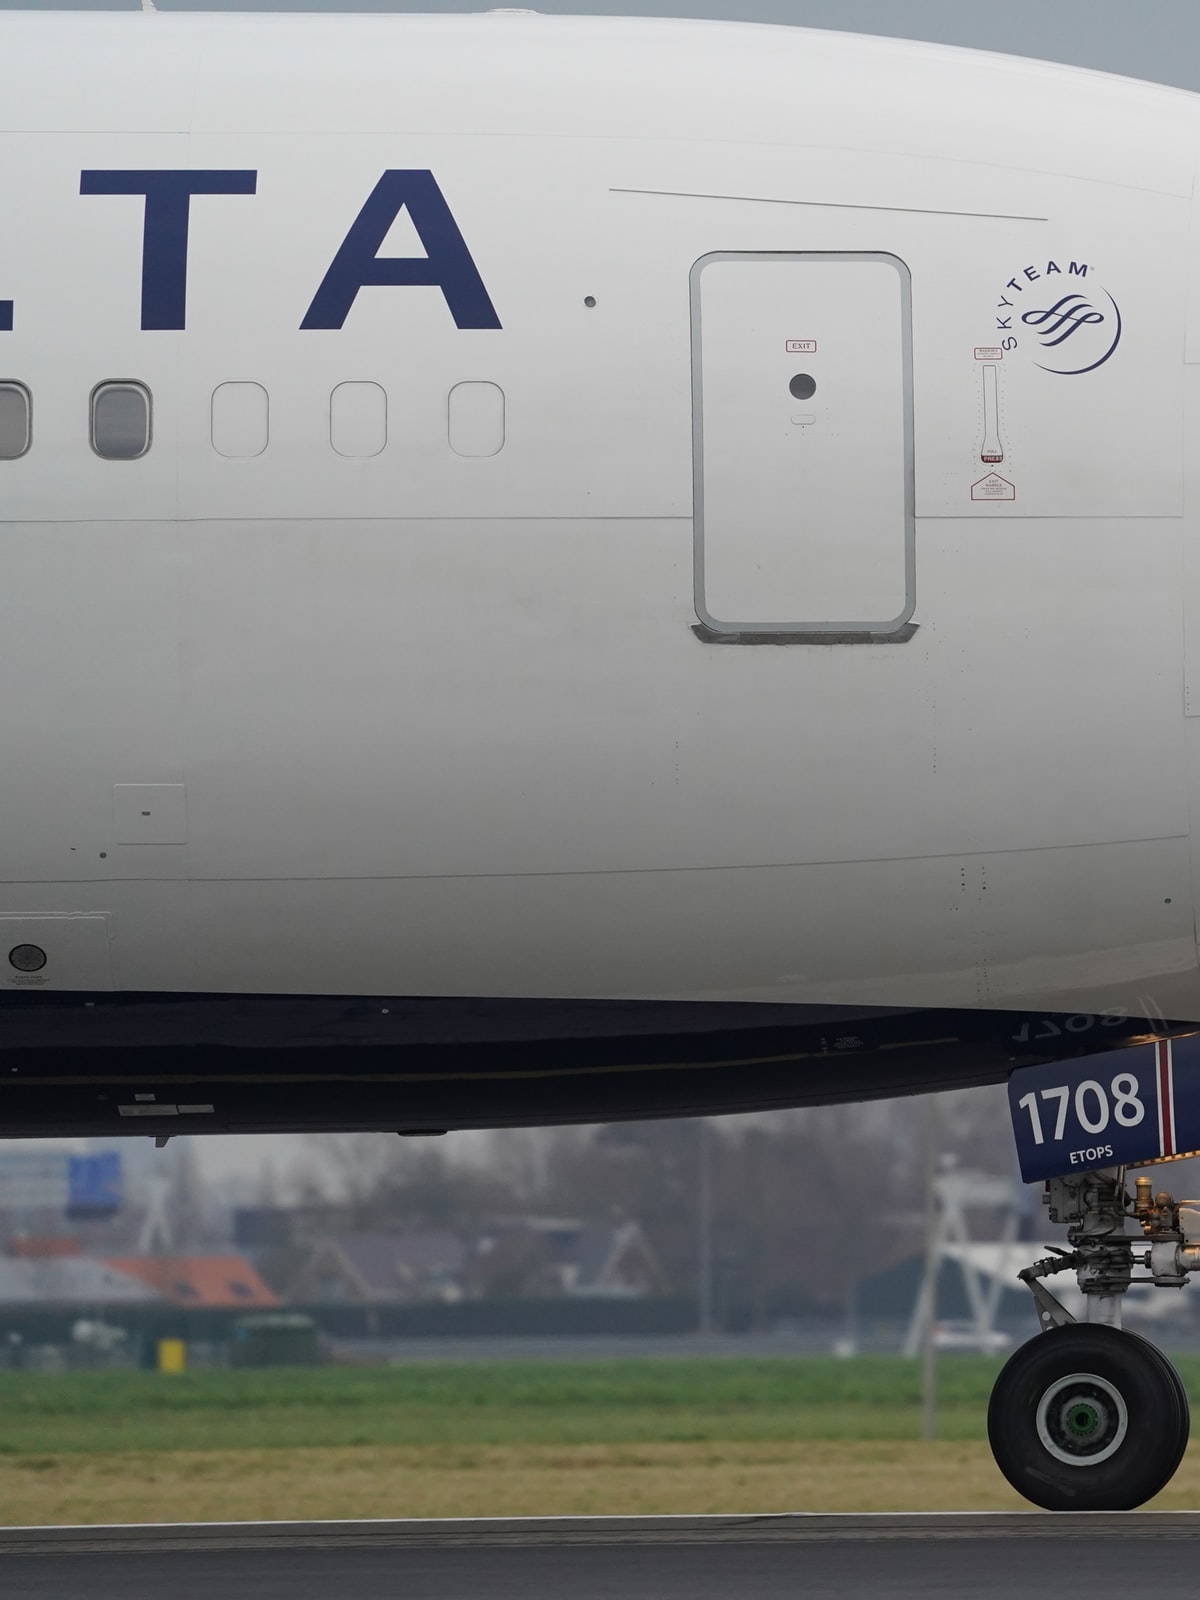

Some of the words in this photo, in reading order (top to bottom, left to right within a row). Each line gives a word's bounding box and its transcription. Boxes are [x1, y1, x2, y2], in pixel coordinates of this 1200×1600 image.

[0, 169, 503, 331] TA
[996, 260, 1088, 351] SKYTEAM
[1018, 1072, 1145, 1145] 1708
[1069, 1145, 1113, 1164] ETOPS
